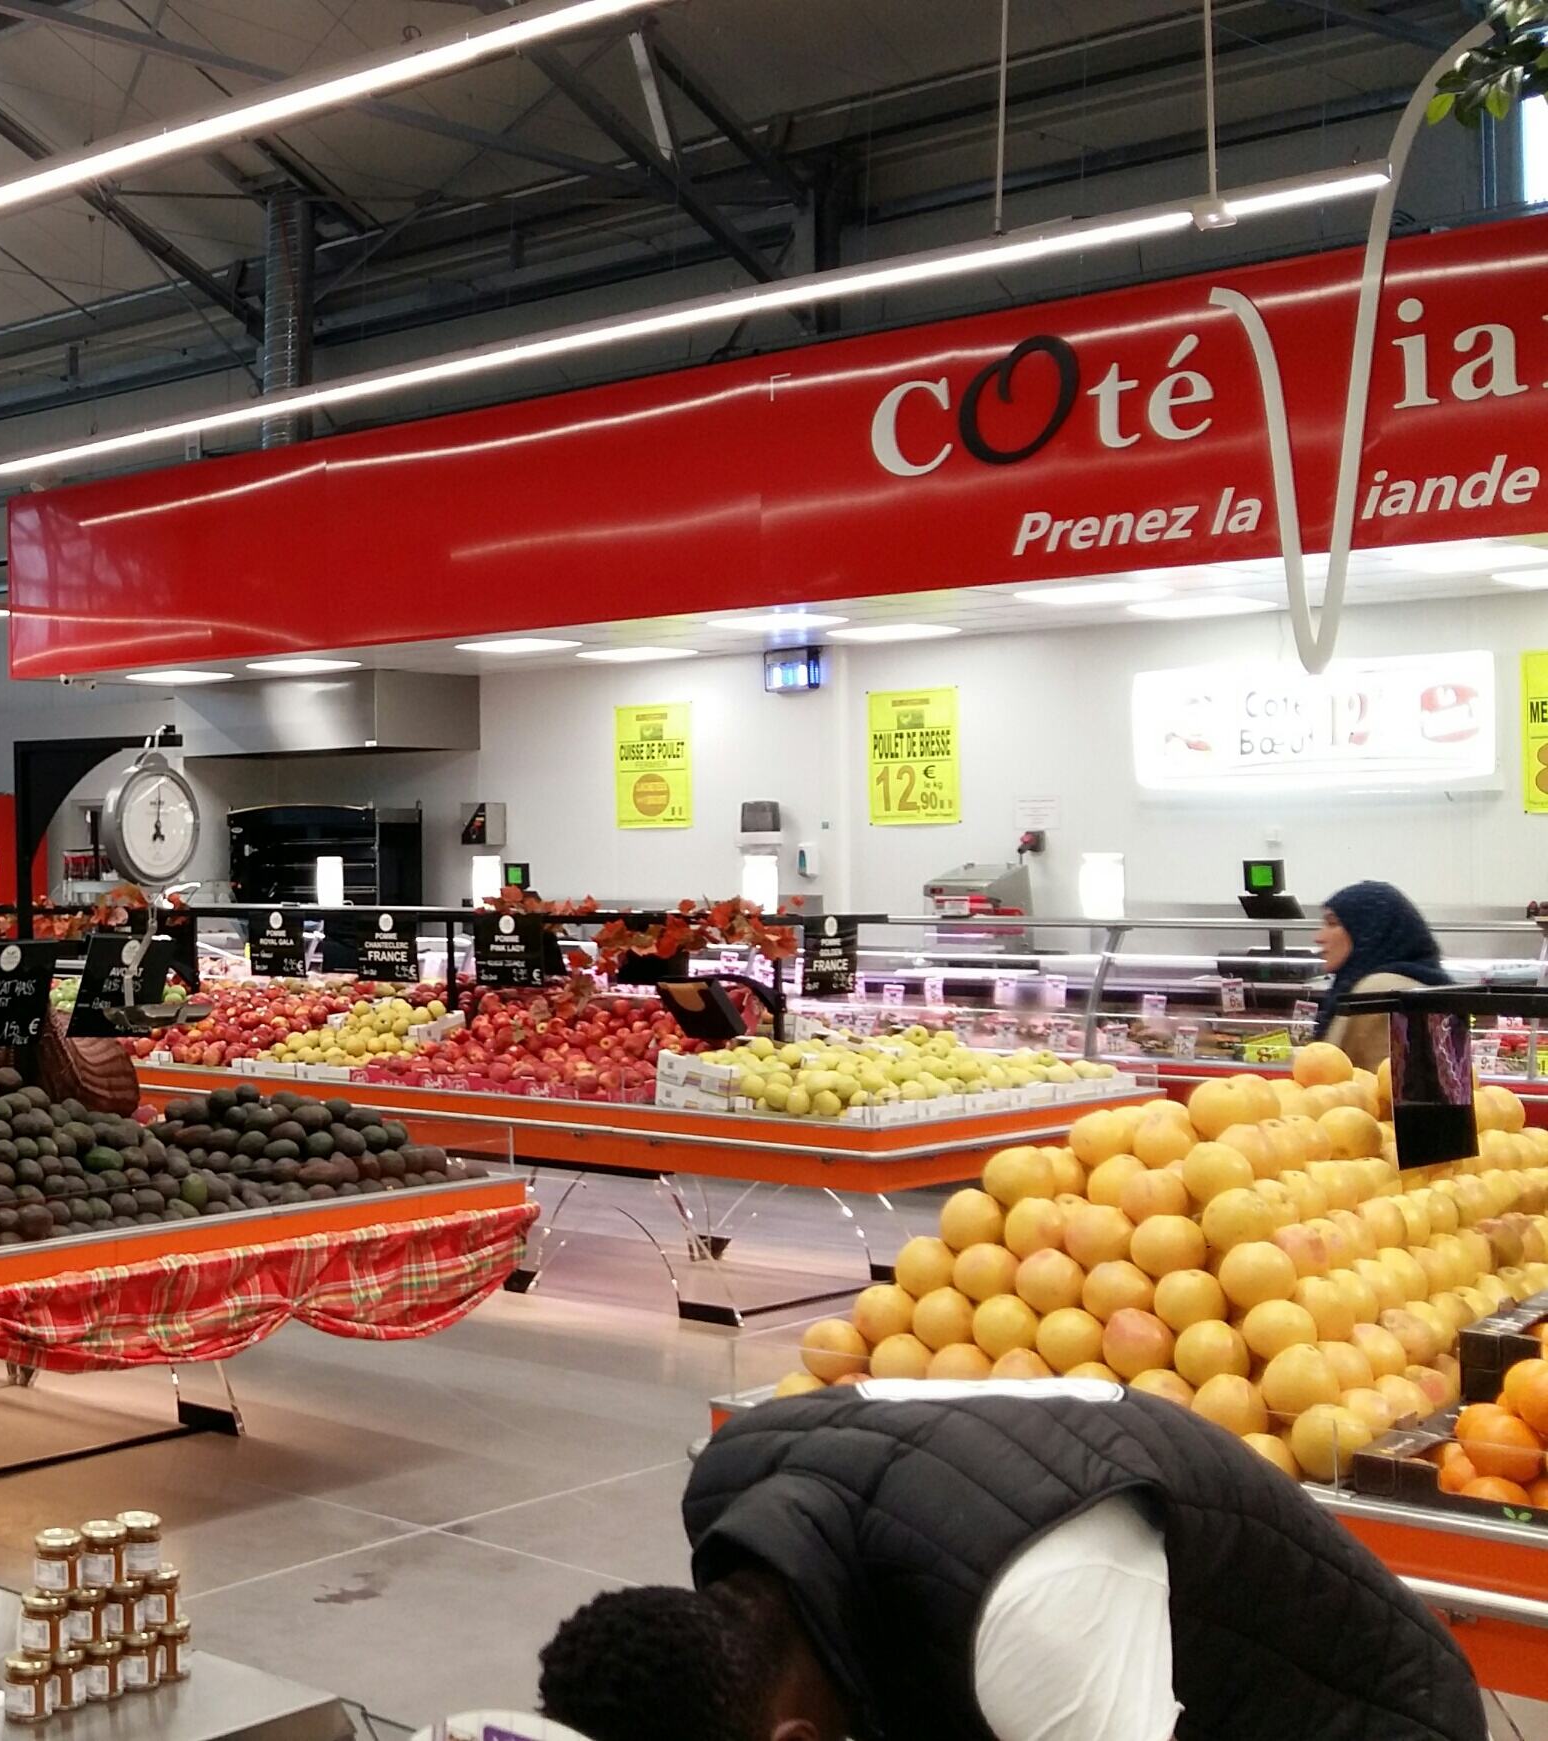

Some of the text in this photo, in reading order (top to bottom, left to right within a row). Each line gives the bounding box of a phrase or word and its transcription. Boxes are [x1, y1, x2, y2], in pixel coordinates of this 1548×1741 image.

[1011, 502, 1199, 556] Prenez
[1211, 488, 1262, 537] la
[872, 729, 951, 759] POULET DE BRESSE
[619, 741, 685, 761] CUISSE DE POULET
[259, 938, 295, 946] ROYAL GALA
[374, 932, 398, 940] POMME
[506, 944, 526, 953] LADY
[368, 950, 409, 963] FRANCE
[812, 958, 849, 972] FRANCE
